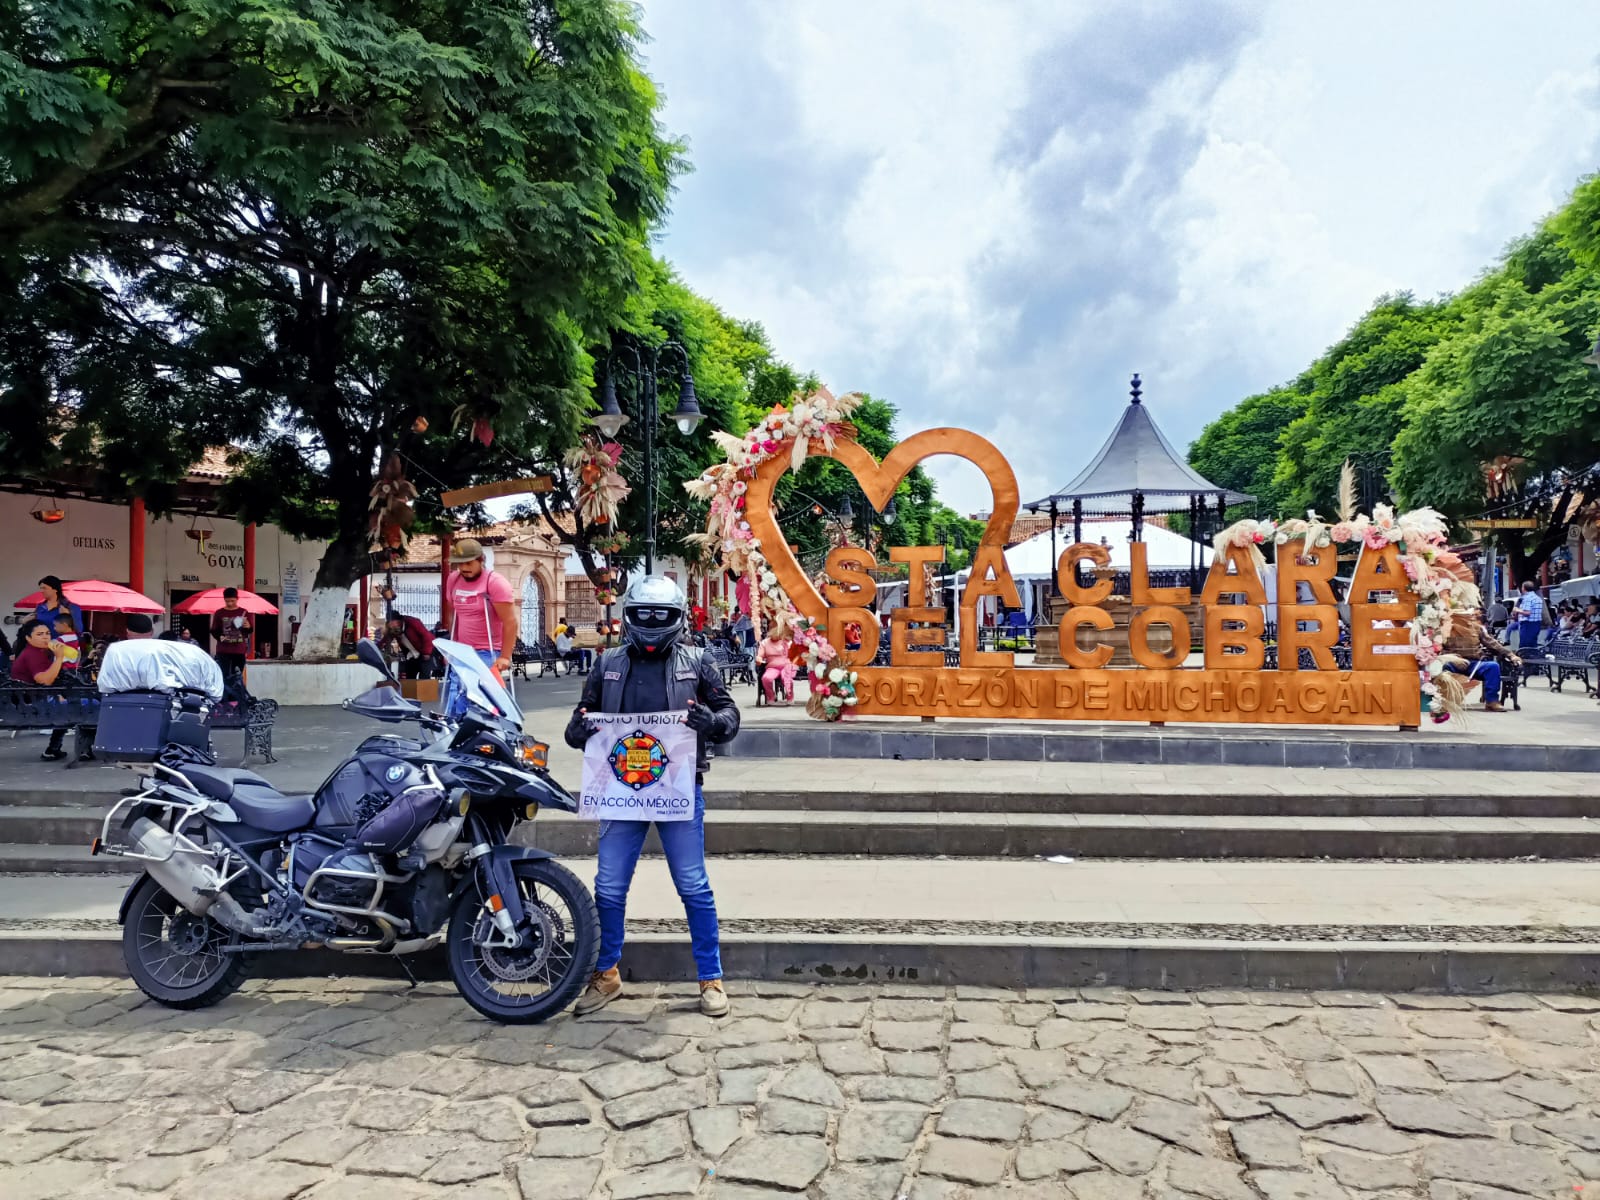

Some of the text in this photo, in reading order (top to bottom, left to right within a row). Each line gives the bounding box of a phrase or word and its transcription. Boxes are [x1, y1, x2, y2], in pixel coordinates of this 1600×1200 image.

[208, 553, 245, 569] GOYA
[825, 541, 1418, 607] STA CLARA
[828, 604, 1418, 672] DEL COBRE
[855, 669, 1393, 713] CORAZÓN DE MICHOACÁN
[583, 795, 690, 808] EN ACCIÓN MÉXICO
